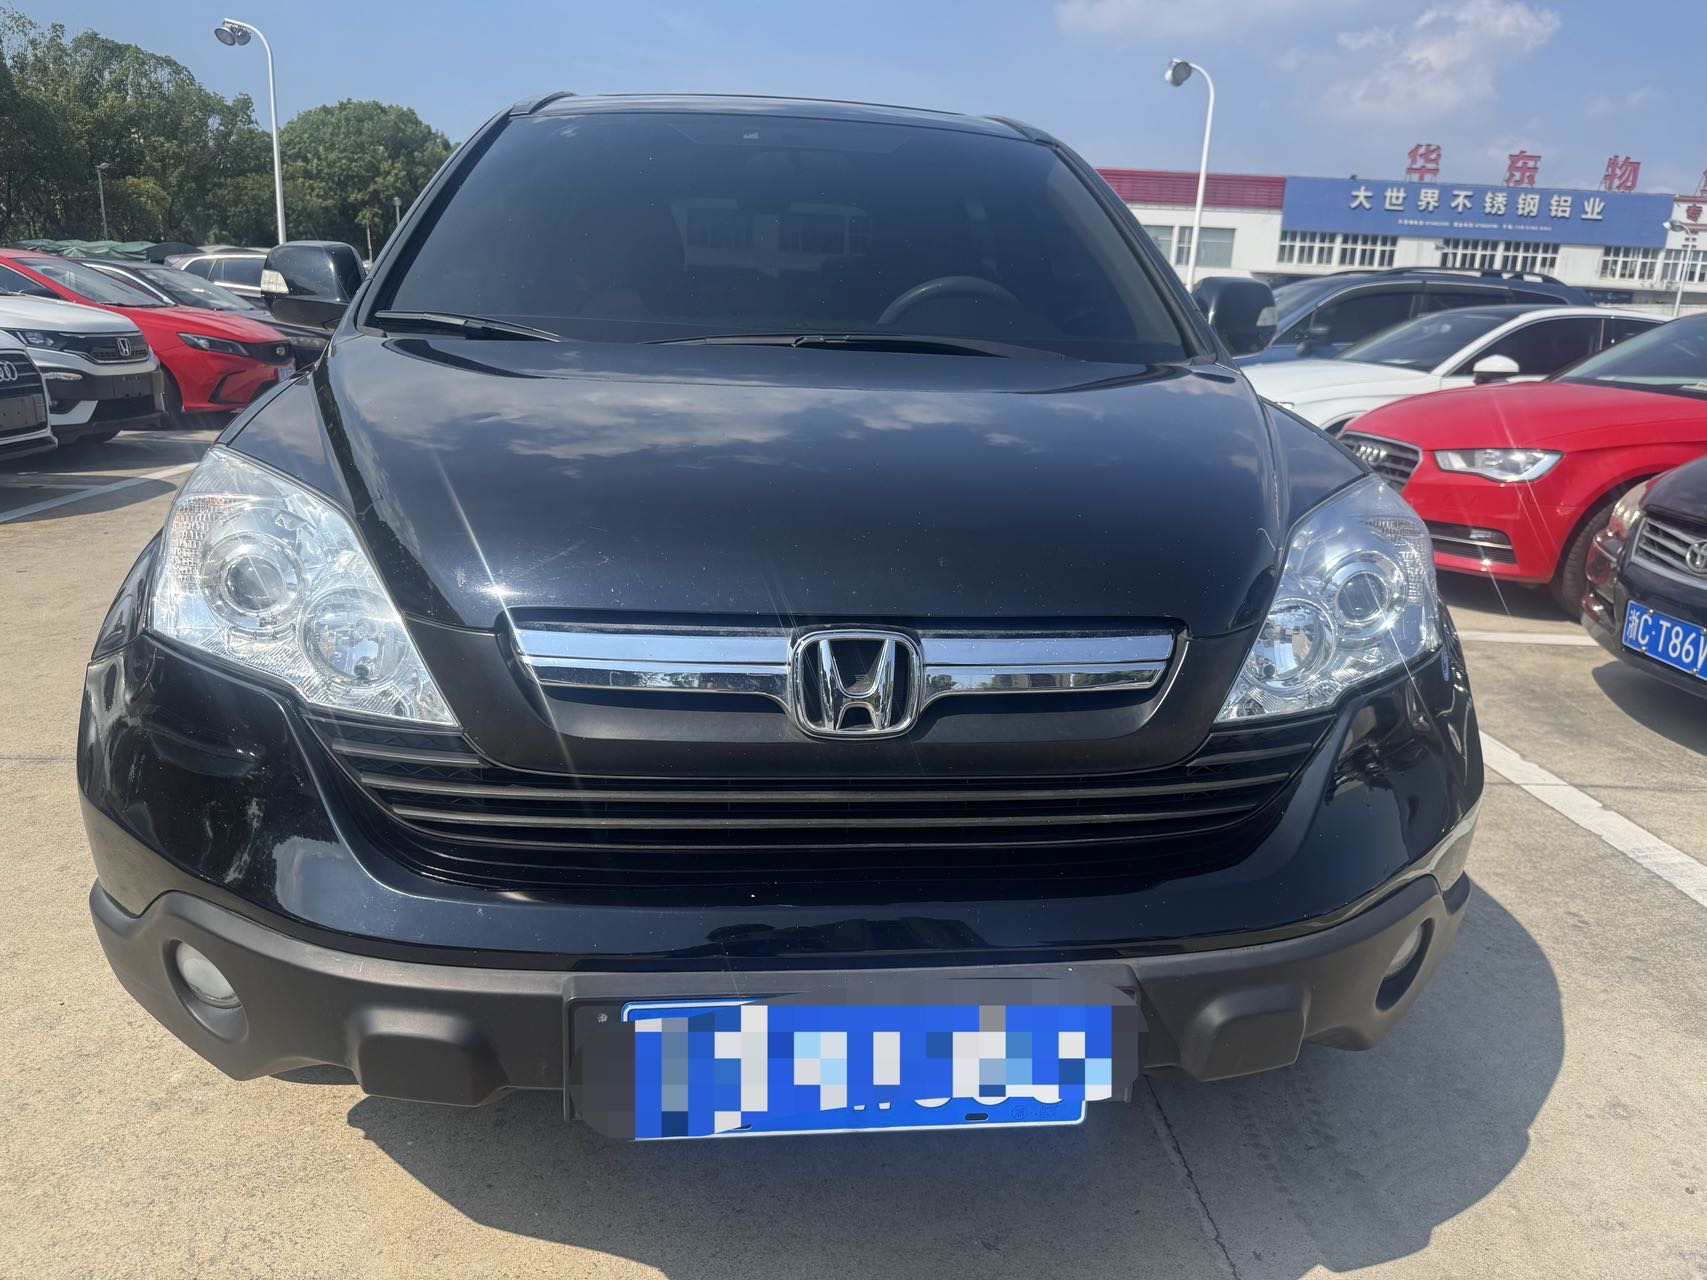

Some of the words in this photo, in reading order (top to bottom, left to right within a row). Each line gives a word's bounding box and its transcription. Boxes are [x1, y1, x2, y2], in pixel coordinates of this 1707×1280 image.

[1407, 143, 1707, 193] 华东物
[1350, 186, 1607, 220] 大世界不锈钢铝业
